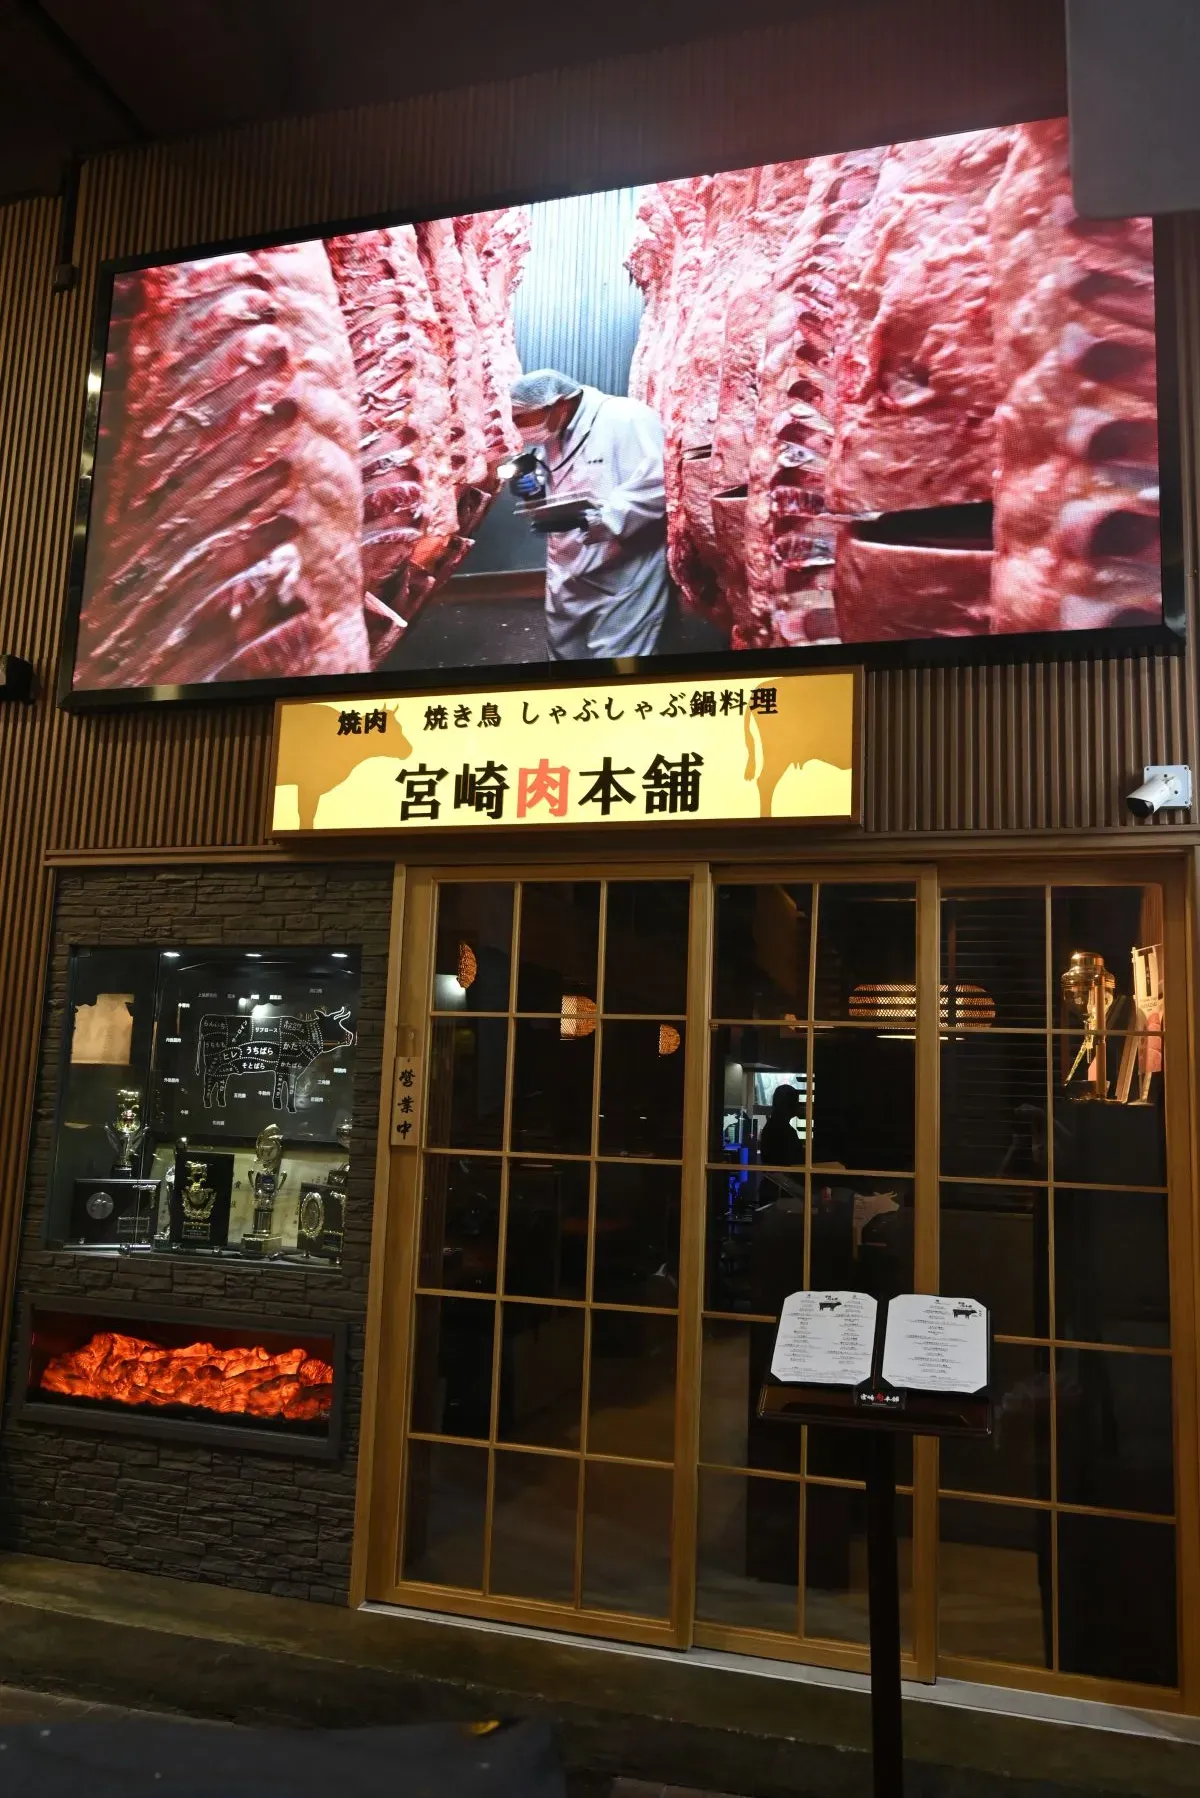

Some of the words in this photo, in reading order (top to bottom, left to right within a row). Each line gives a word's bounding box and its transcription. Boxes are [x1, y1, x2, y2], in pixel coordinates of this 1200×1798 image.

[337, 708, 387, 735] 焼肉
[423, 702, 501, 731] 焼き鳥
[521, 687, 778, 725] しゃぶしゃぶ鍋料理
[246, 1046, 274, 1056] うちばら
[282, 1042, 299, 1051] かた
[223, 1050, 238, 1060] ヒレ
[241, 1062, 266, 1070] そとばら
[280, 1061, 303, 1069] かたばら
